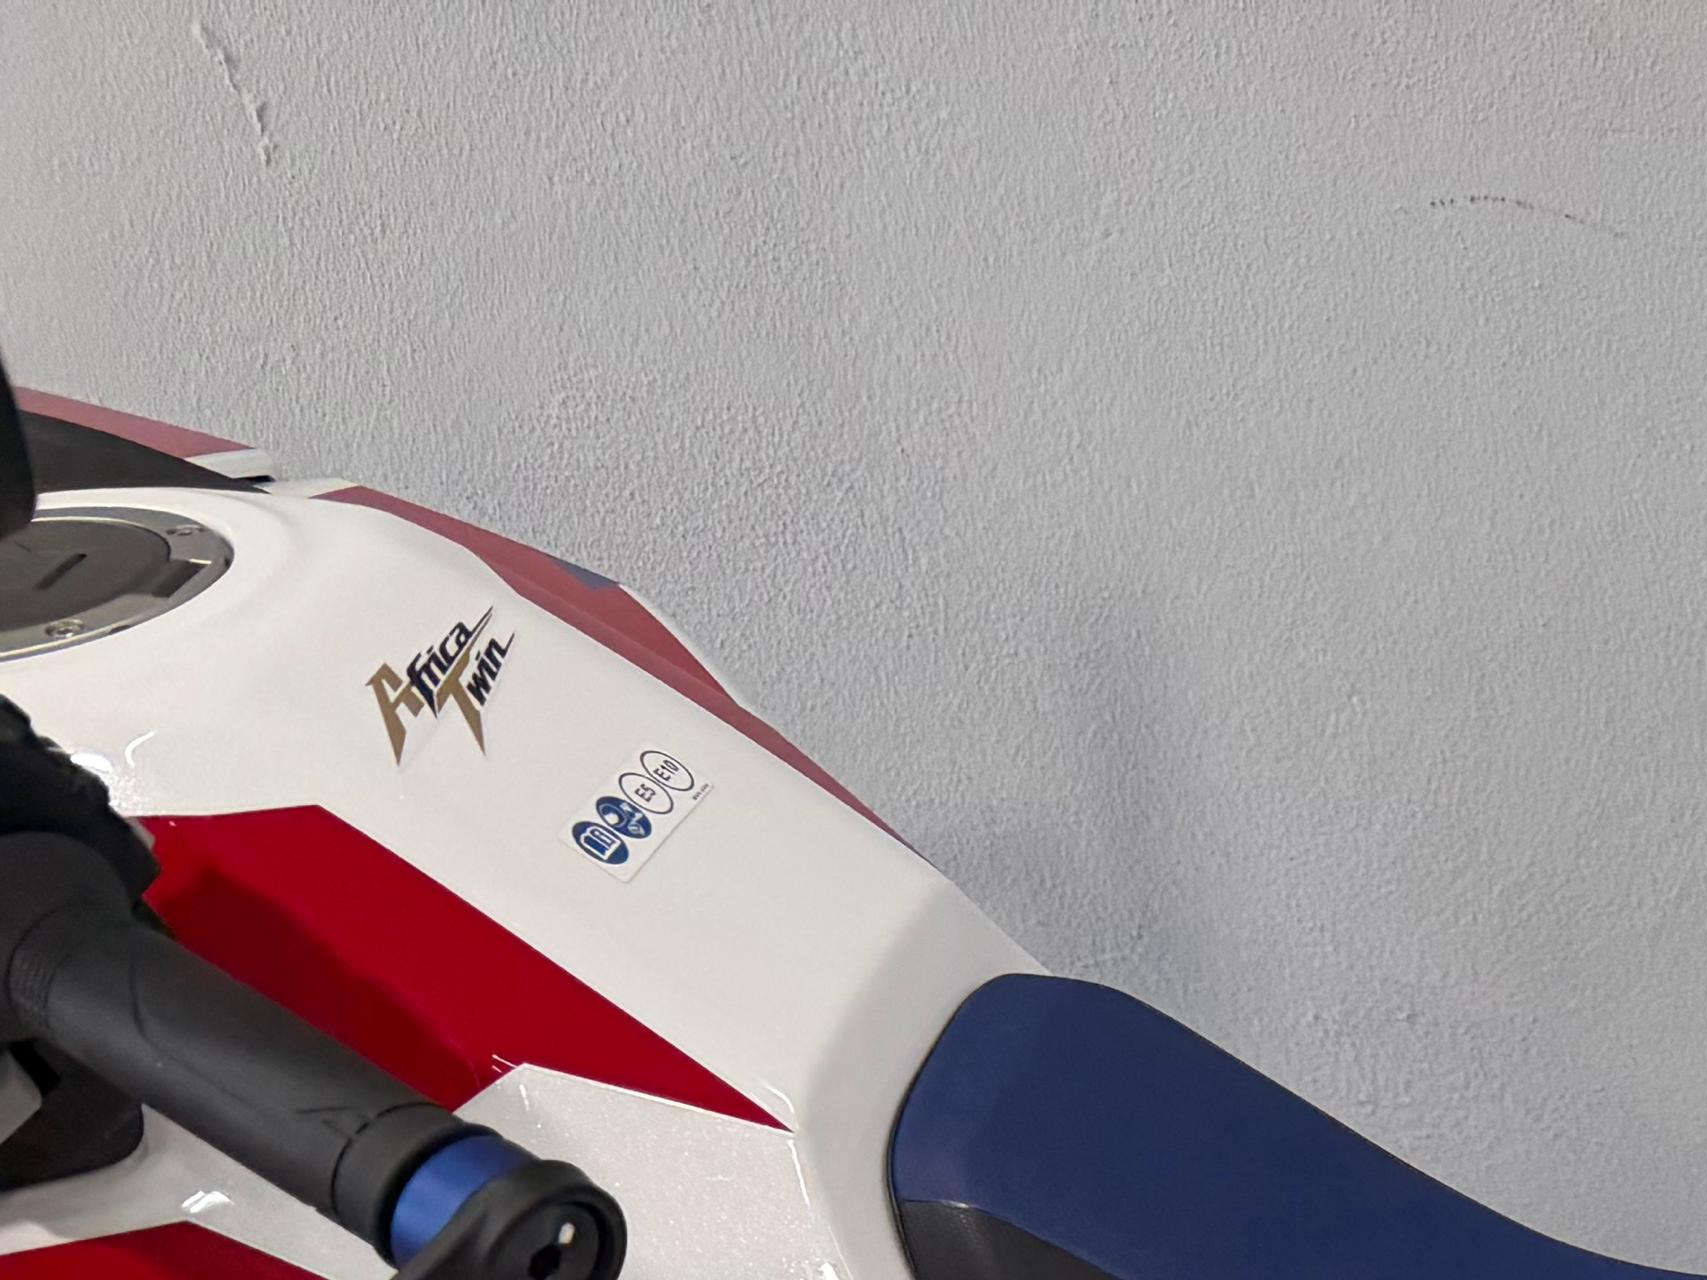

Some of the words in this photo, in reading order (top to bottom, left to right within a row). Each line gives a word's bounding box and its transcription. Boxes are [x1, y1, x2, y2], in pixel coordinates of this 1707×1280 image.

[365, 605, 493, 767] Africa
[434, 614, 516, 757] Twin
[634, 782, 657, 803] E5
[653, 759, 679, 782] E10
